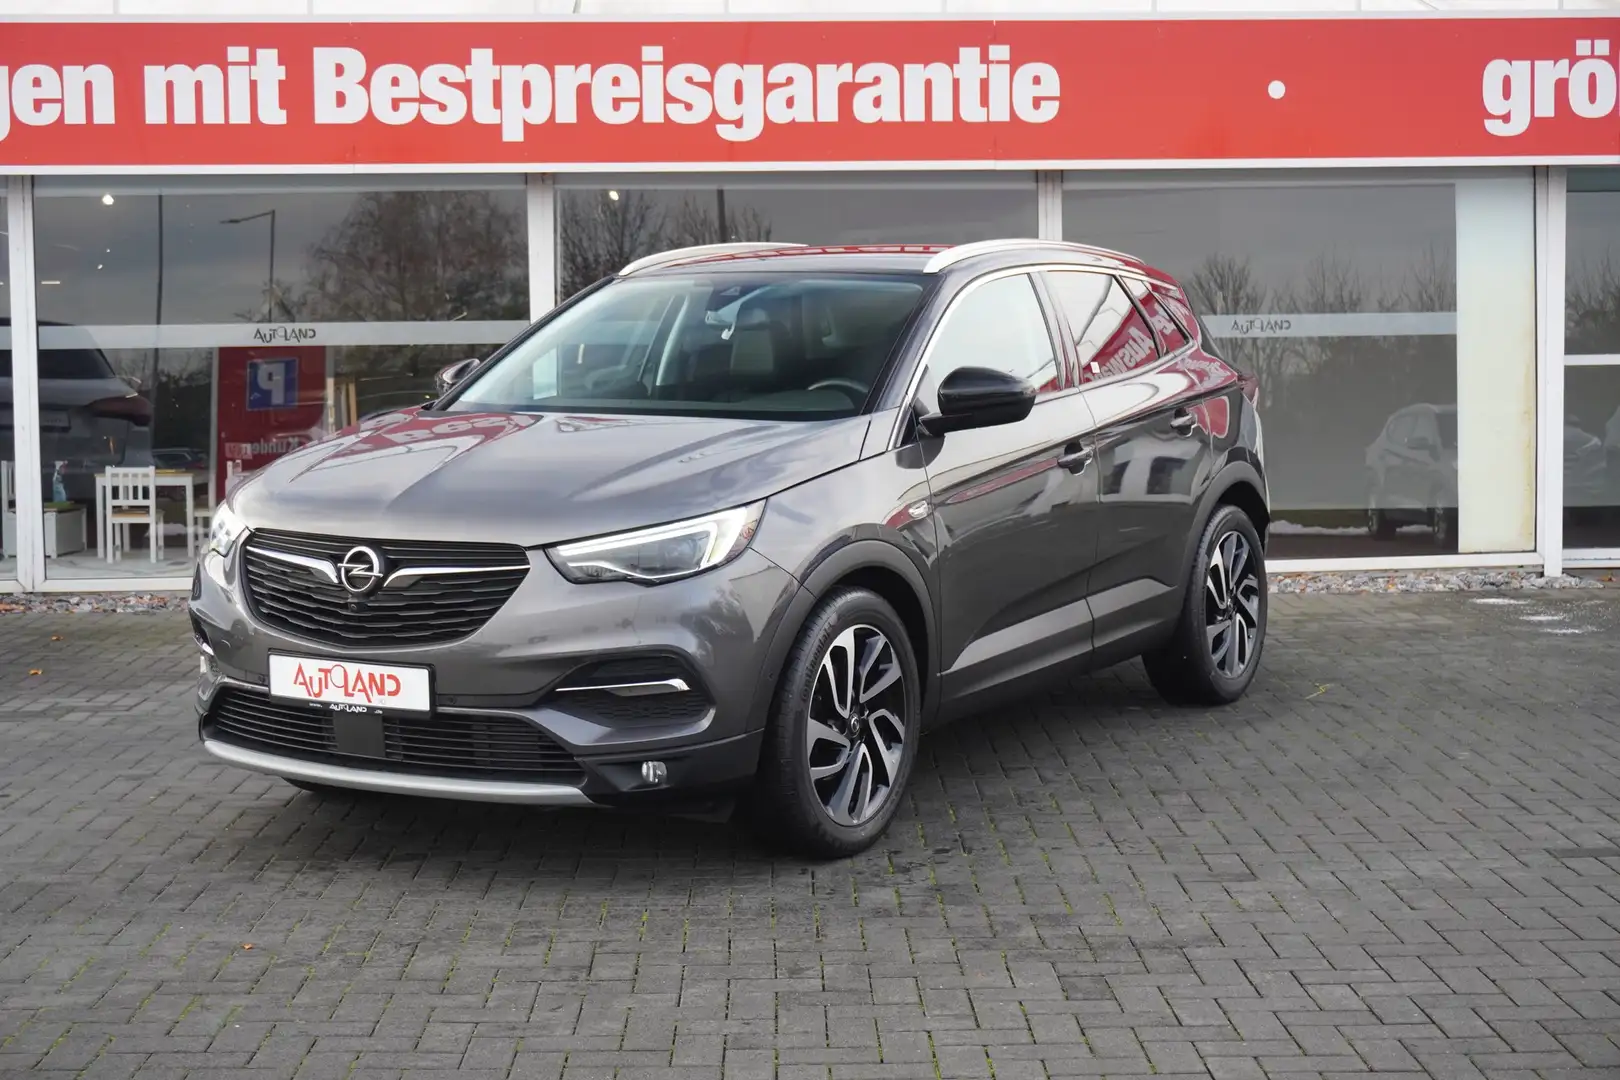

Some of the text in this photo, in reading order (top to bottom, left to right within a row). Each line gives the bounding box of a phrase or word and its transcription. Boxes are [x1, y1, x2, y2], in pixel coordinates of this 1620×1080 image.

[0, 44, 1061, 142] en mit Bestpreisgarantie
[1482, 39, 1620, 137] grö
[293, 663, 402, 703] AUTOLAND
[329, 703, 367, 714] AUTOLAND
